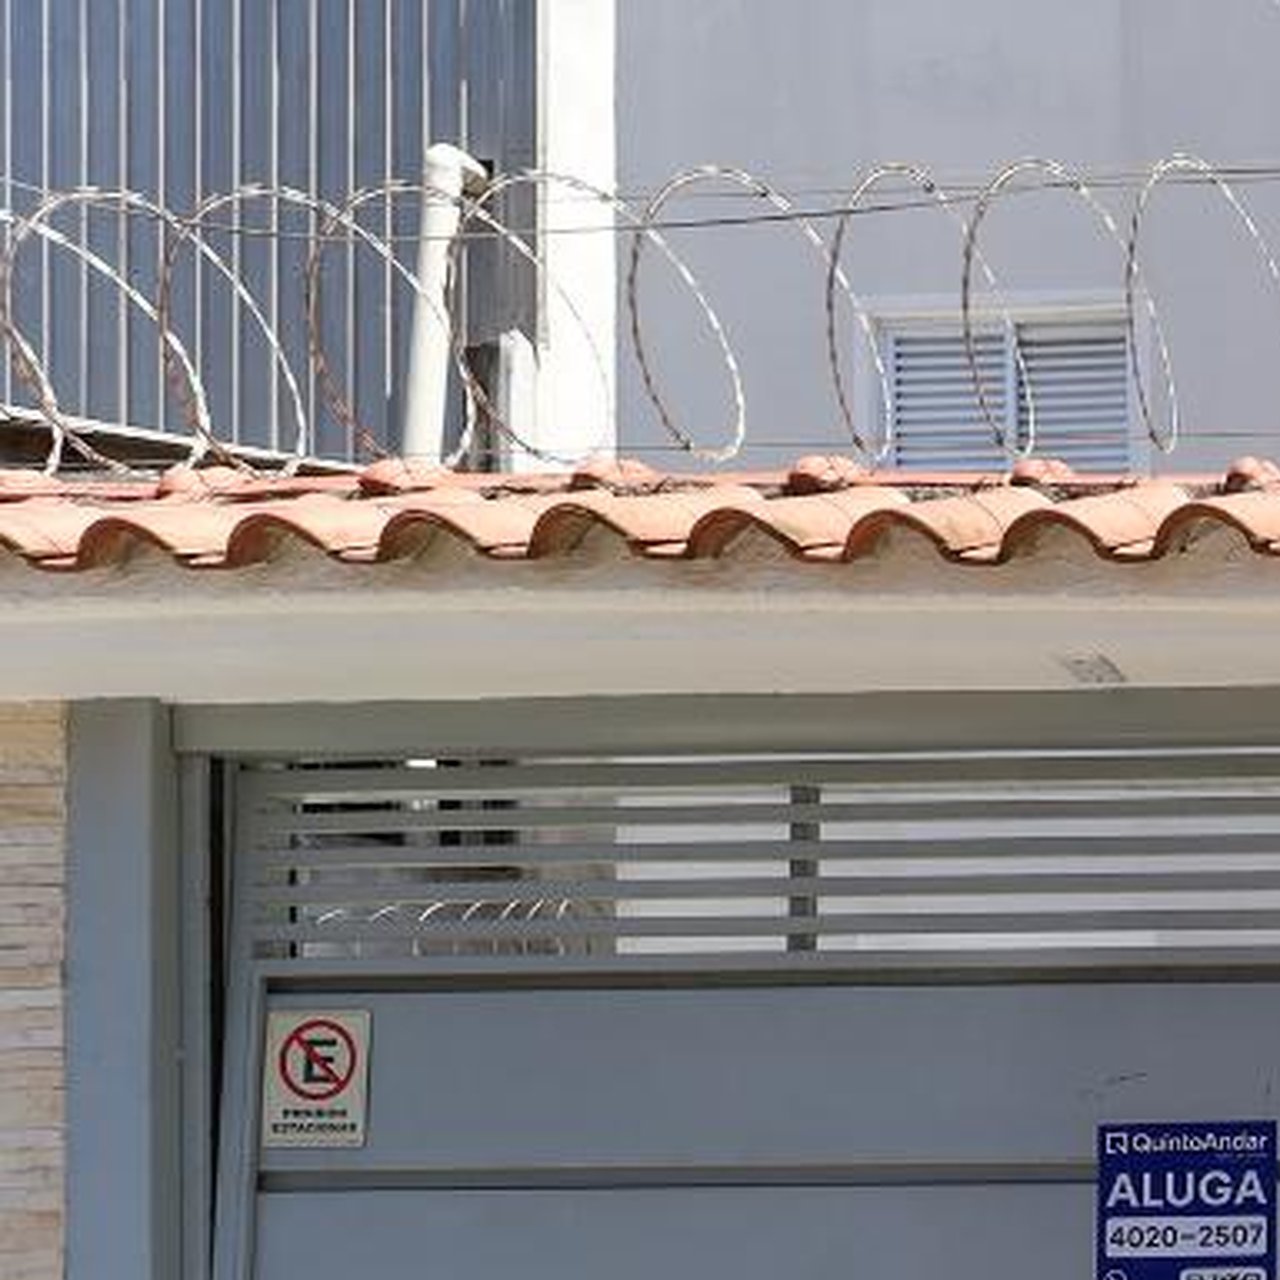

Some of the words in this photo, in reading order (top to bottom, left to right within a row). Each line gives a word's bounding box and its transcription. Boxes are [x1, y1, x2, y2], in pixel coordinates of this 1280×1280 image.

[1132, 1131, 1268, 1152] QuintoAndar
[1106, 1170, 1267, 1207] ALUGA
[1109, 1225, 1264, 1248] 4020-2507
